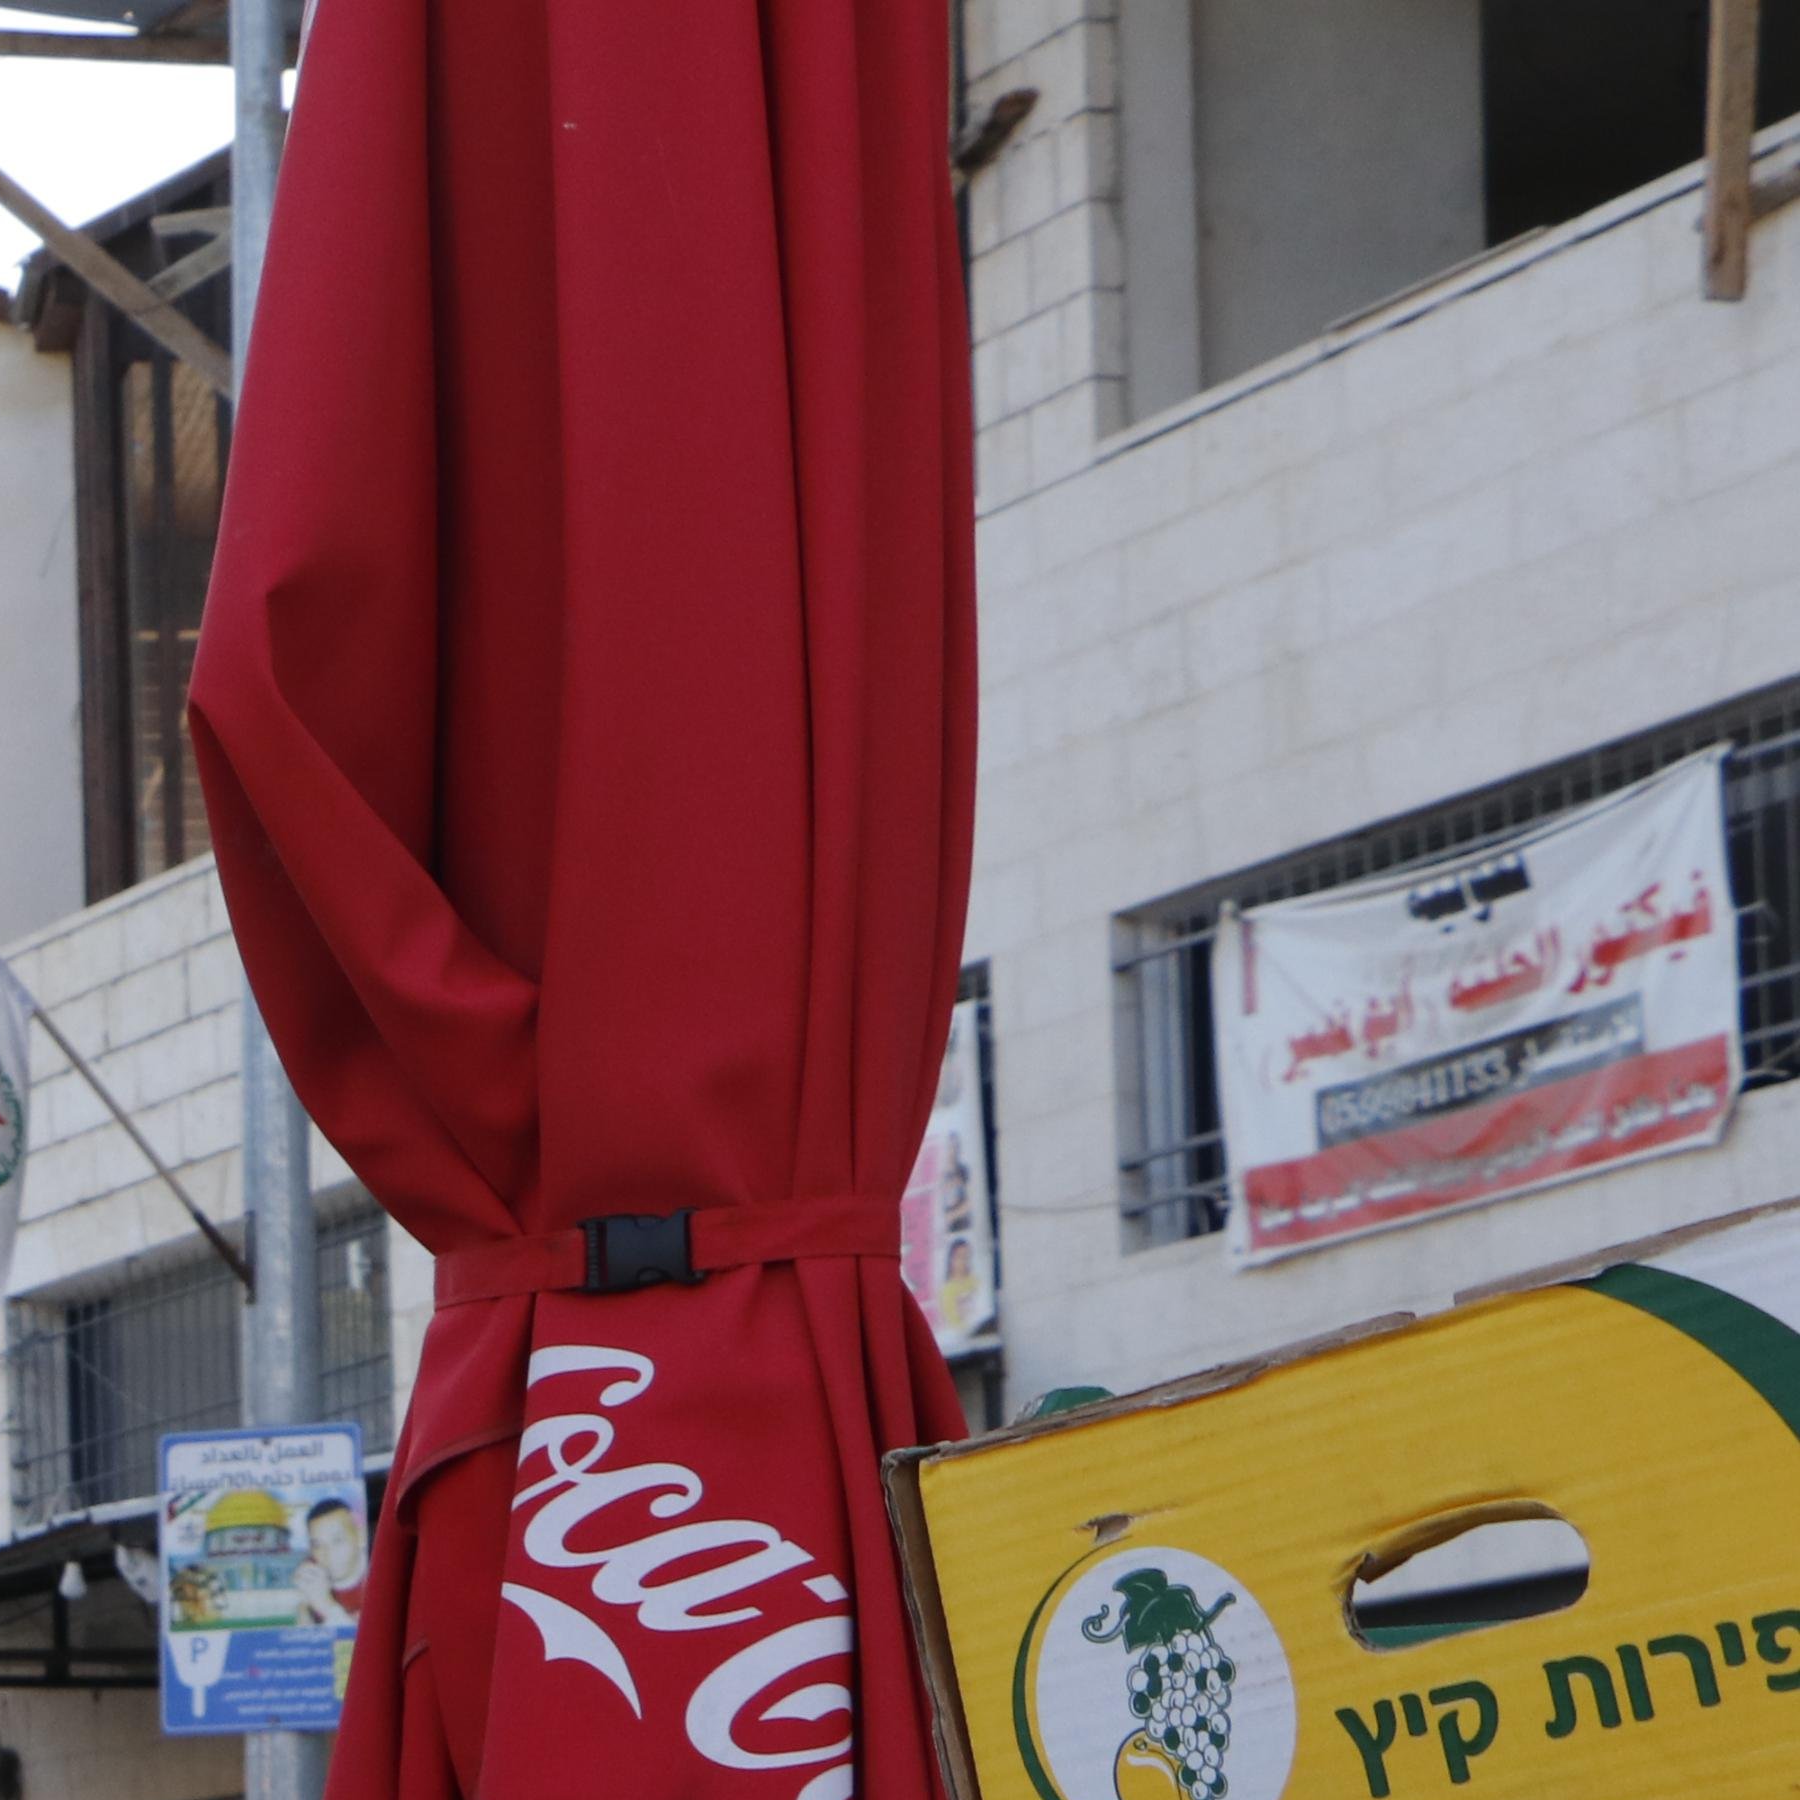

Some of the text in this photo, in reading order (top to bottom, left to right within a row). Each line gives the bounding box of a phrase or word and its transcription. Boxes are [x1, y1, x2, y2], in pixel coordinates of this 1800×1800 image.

[191, 1637, 208, 1663] P
[1335, 1609, 1800, 1799] פירות קיץ
